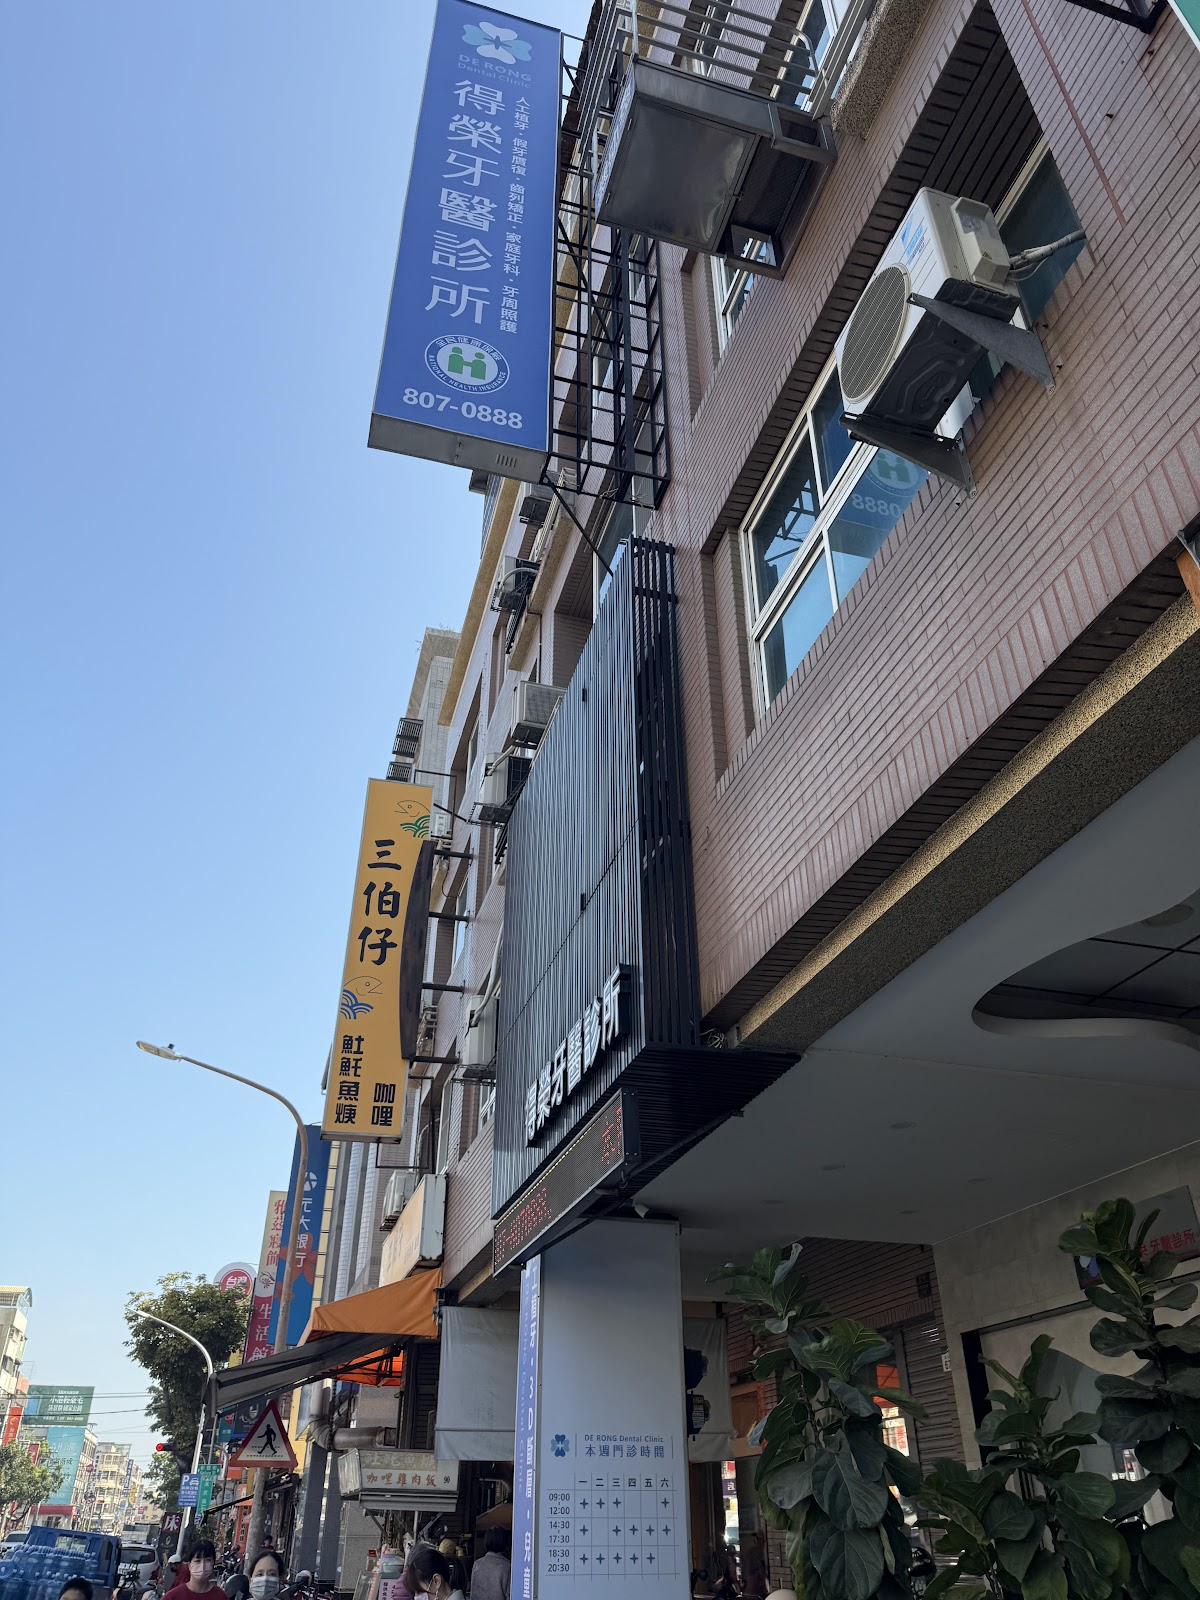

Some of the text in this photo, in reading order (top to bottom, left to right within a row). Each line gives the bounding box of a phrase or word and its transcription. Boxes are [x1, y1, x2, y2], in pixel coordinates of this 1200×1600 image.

[459, 54, 532, 82] DE RONG
[458, 62, 531, 89] Dental Clinic
[424, 79, 505, 325] 得榮牙醫診所
[448, 379, 479, 392] HEALTH
[478, 371, 507, 392] INSURANCE
[402, 387, 523, 429] 807-0888
[357, 839, 402, 966] 三伯仔
[525, 963, 622, 1142] 得榮牙醫診所
[371, 1082, 397, 1127] 咖哩
[584, 1434, 664, 1443] DE RONG Dental Clinic
[585, 1444, 665, 1458] 本週門診時間
[181, 1475, 190, 1486] P
[595, 1478, 604, 1487] 二
[612, 1478, 621, 1487] 三
[628, 1478, 637, 1487] 四
[644, 1478, 653, 1488] 五
[660, 1477, 669, 1488] 六
[548, 1493, 570, 1501] 09:00
[549, 1506, 570, 1515] 12:00
[163, 1514, 181, 1531] 床
[549, 1520, 570, 1529] 14:30
[549, 1535, 570, 1543] 17:30
[549, 1549, 570, 1558] 18:30
[548, 1563, 570, 1572] 20:30
